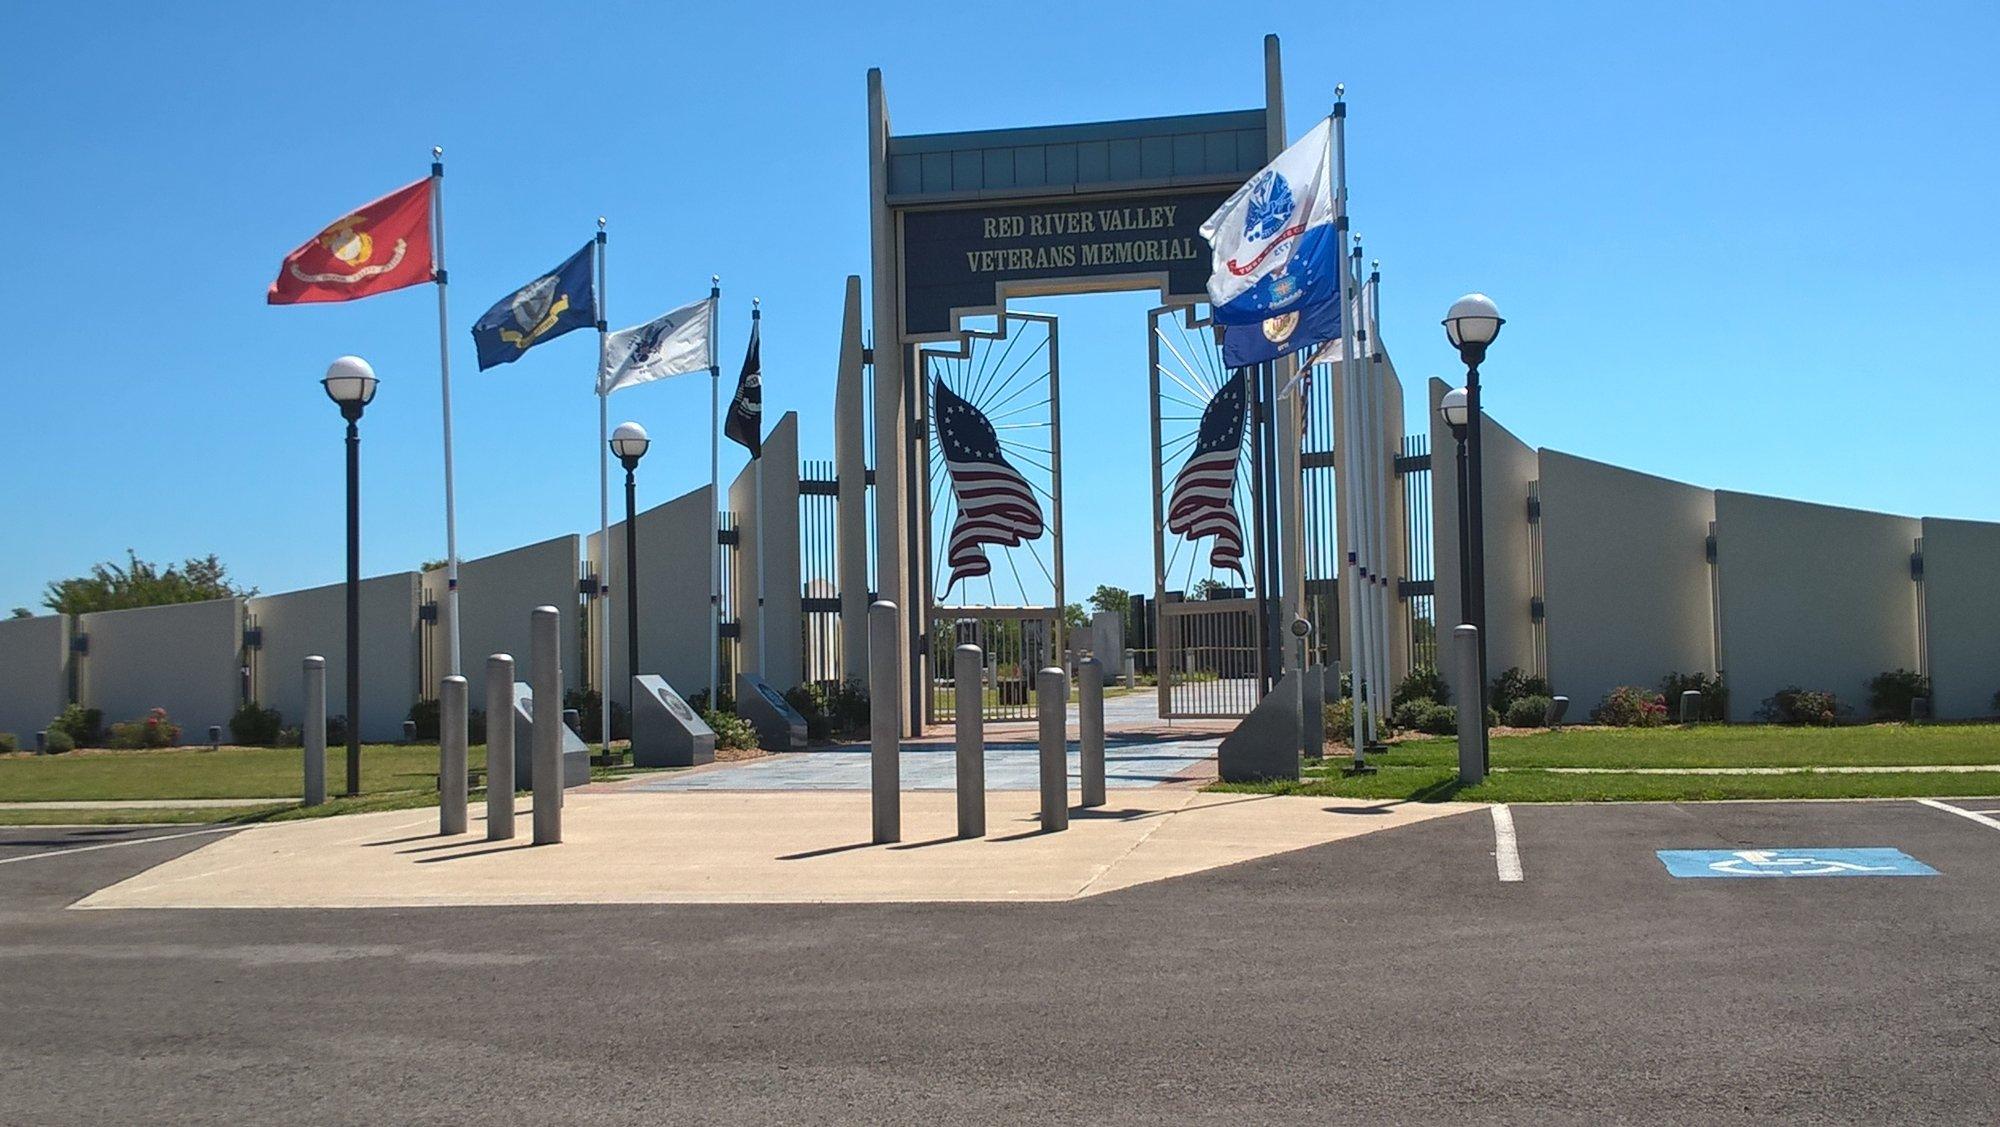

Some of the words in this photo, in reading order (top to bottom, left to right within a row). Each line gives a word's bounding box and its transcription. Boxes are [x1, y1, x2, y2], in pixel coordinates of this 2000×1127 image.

[984, 216, 1024, 239] RED
[1031, 211, 1095, 236] RIVER
[1099, 206, 1177, 232] VALLEY
[967, 246, 1076, 272] VETERANS
[1081, 238, 1197, 266] MEMORIAL
